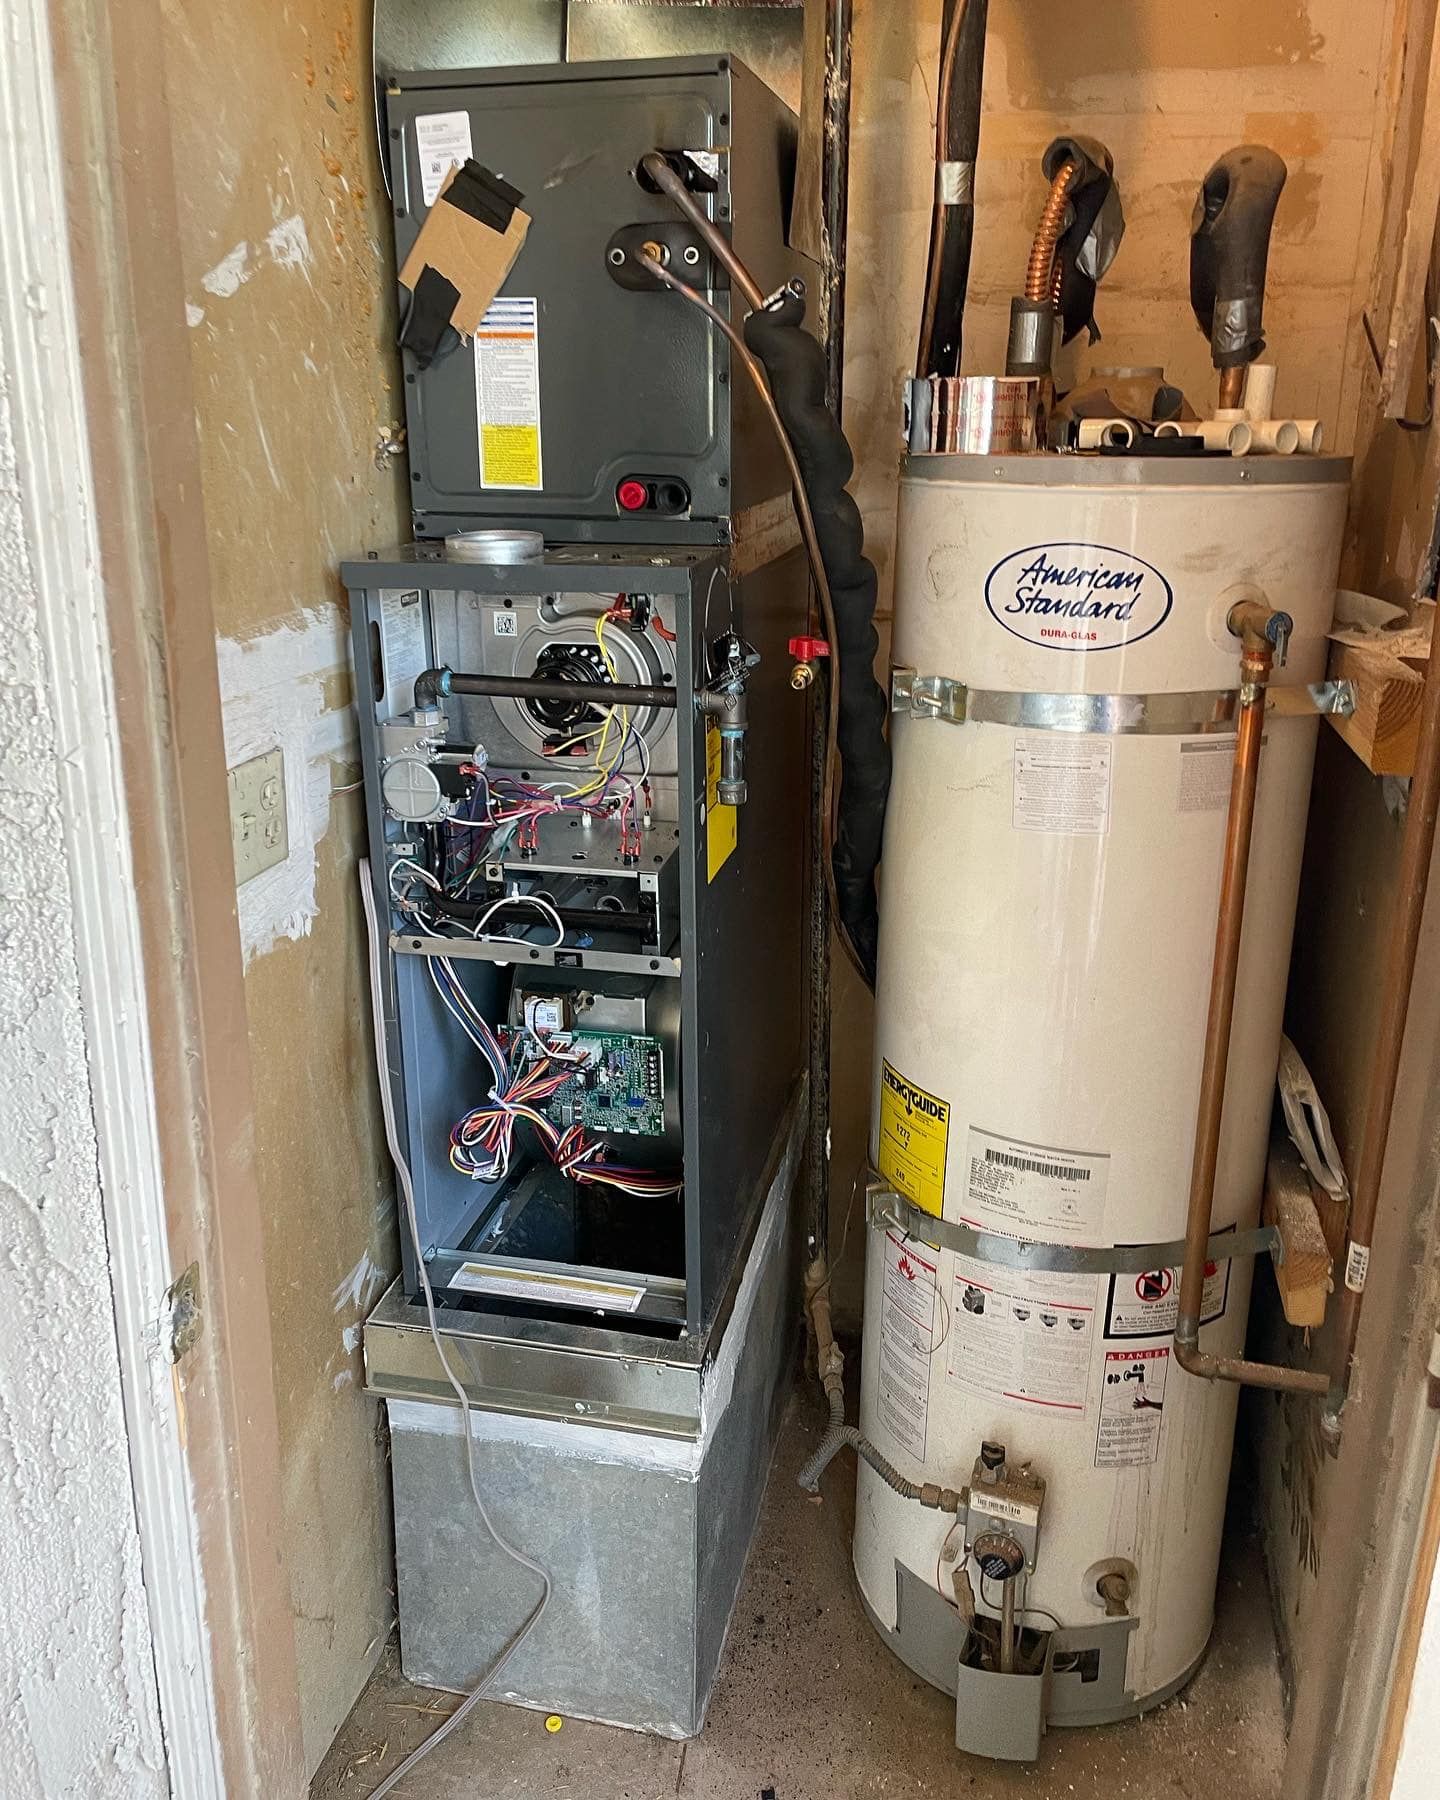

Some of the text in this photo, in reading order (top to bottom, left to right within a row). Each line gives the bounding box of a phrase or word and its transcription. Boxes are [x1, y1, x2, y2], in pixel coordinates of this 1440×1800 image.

[1016, 553, 1145, 592] American
[1004, 586, 1141, 621] Standard
[1040, 628, 1097, 641] DURA-GLAS
[883, 1066, 946, 1123] ENERGYGUIDE
